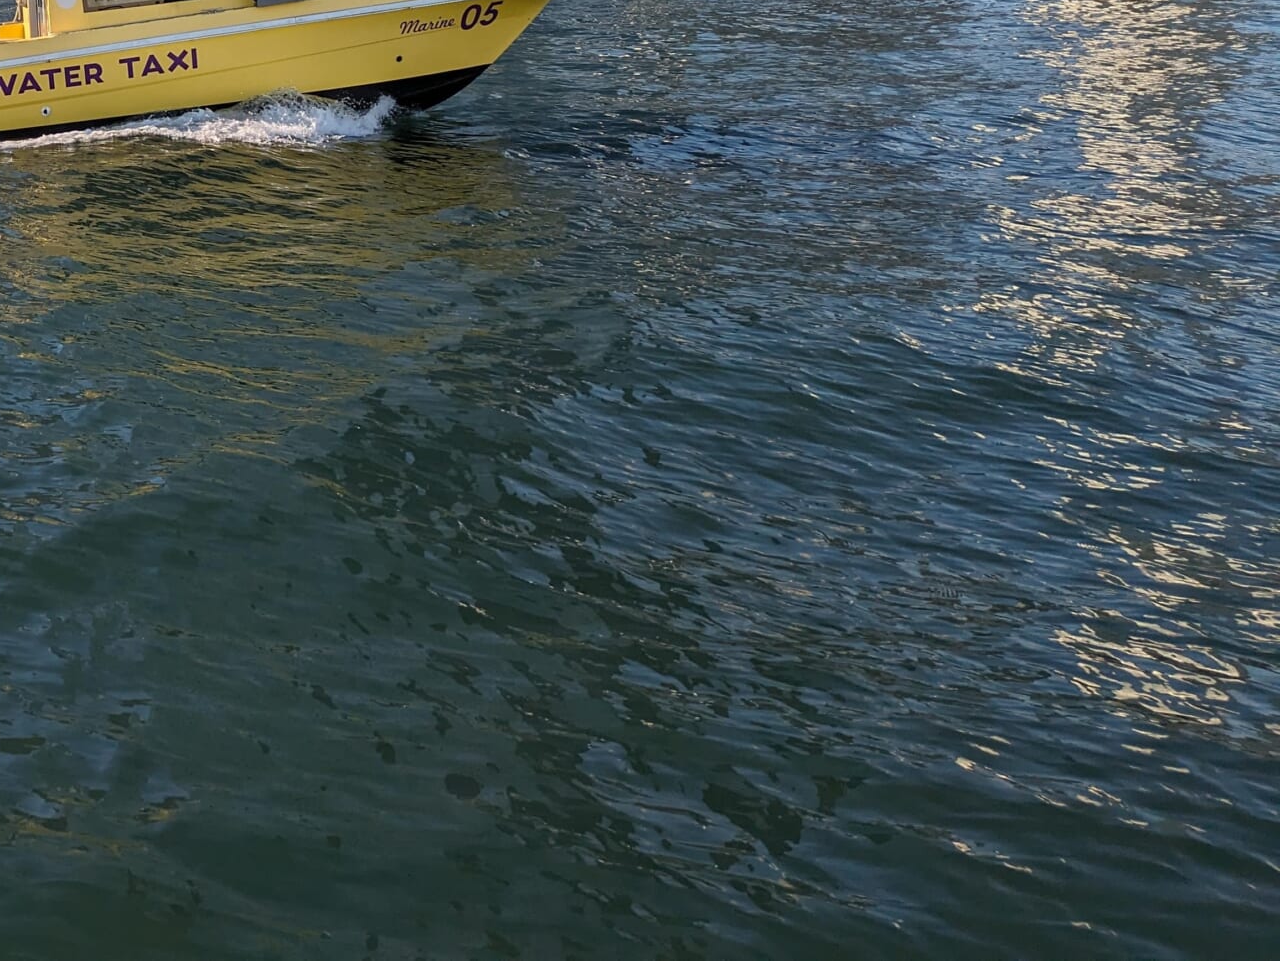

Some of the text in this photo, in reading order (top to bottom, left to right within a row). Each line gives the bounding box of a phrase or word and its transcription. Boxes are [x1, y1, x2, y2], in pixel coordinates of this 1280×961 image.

[400, 0, 504, 34] Marine 05
[118, 48, 198, 79] TAXI
